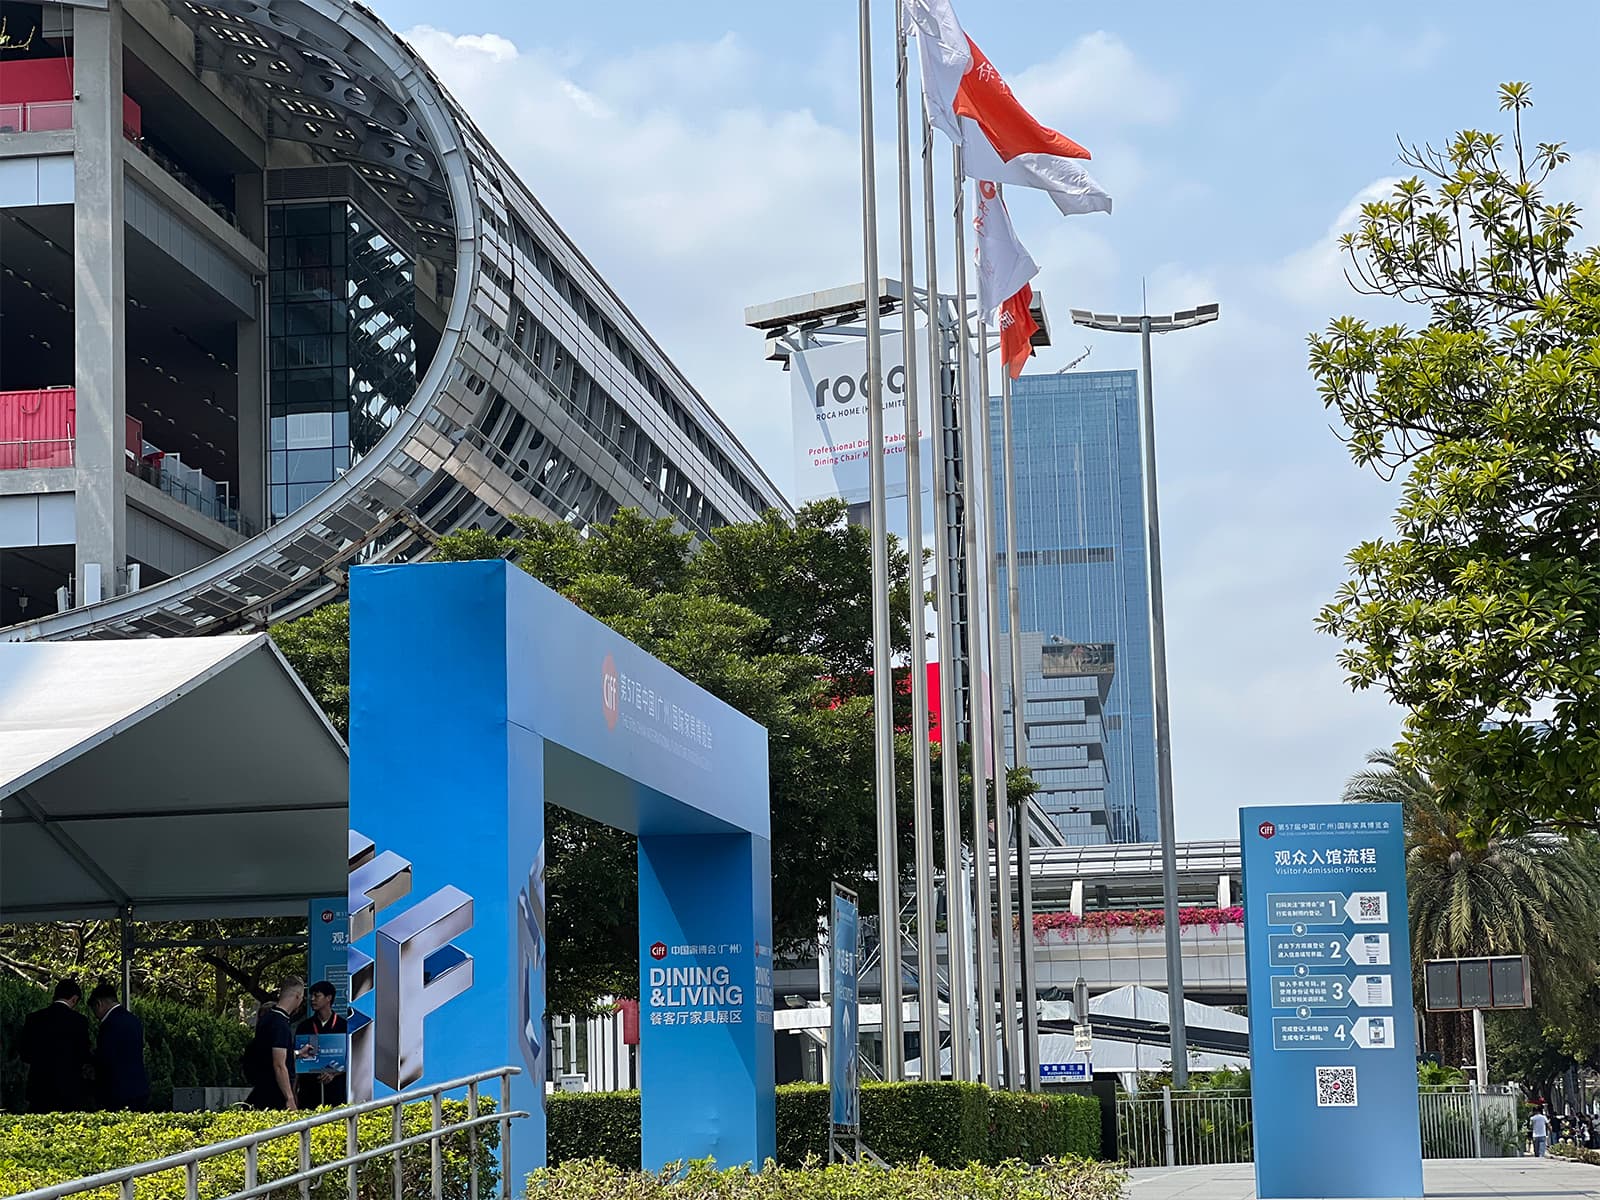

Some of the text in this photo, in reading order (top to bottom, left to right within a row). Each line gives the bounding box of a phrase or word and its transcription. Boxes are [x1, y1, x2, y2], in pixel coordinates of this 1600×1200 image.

[816, 411, 836, 421] ROCA
[838, 407, 860, 417] HOME
[808, 441, 856, 456] Professional
[884, 433, 906, 443] Table
[814, 456, 839, 467] Dining
[840, 452, 861, 463] Chair
[1274, 848, 1377, 866] 观众入馆流程
[1275, 865, 1377, 875] Visitor Admission Process
[1328, 900, 1337, 917] 1
[1330, 941, 1342, 958] 2
[650, 966, 730, 987] DINING
[650, 986, 743, 1007] &LIVING
[1332, 982, 1344, 1000] 3
[650, 1010, 742, 1025] 餐客厅家具展区
[1334, 1024, 1346, 1042] 4
